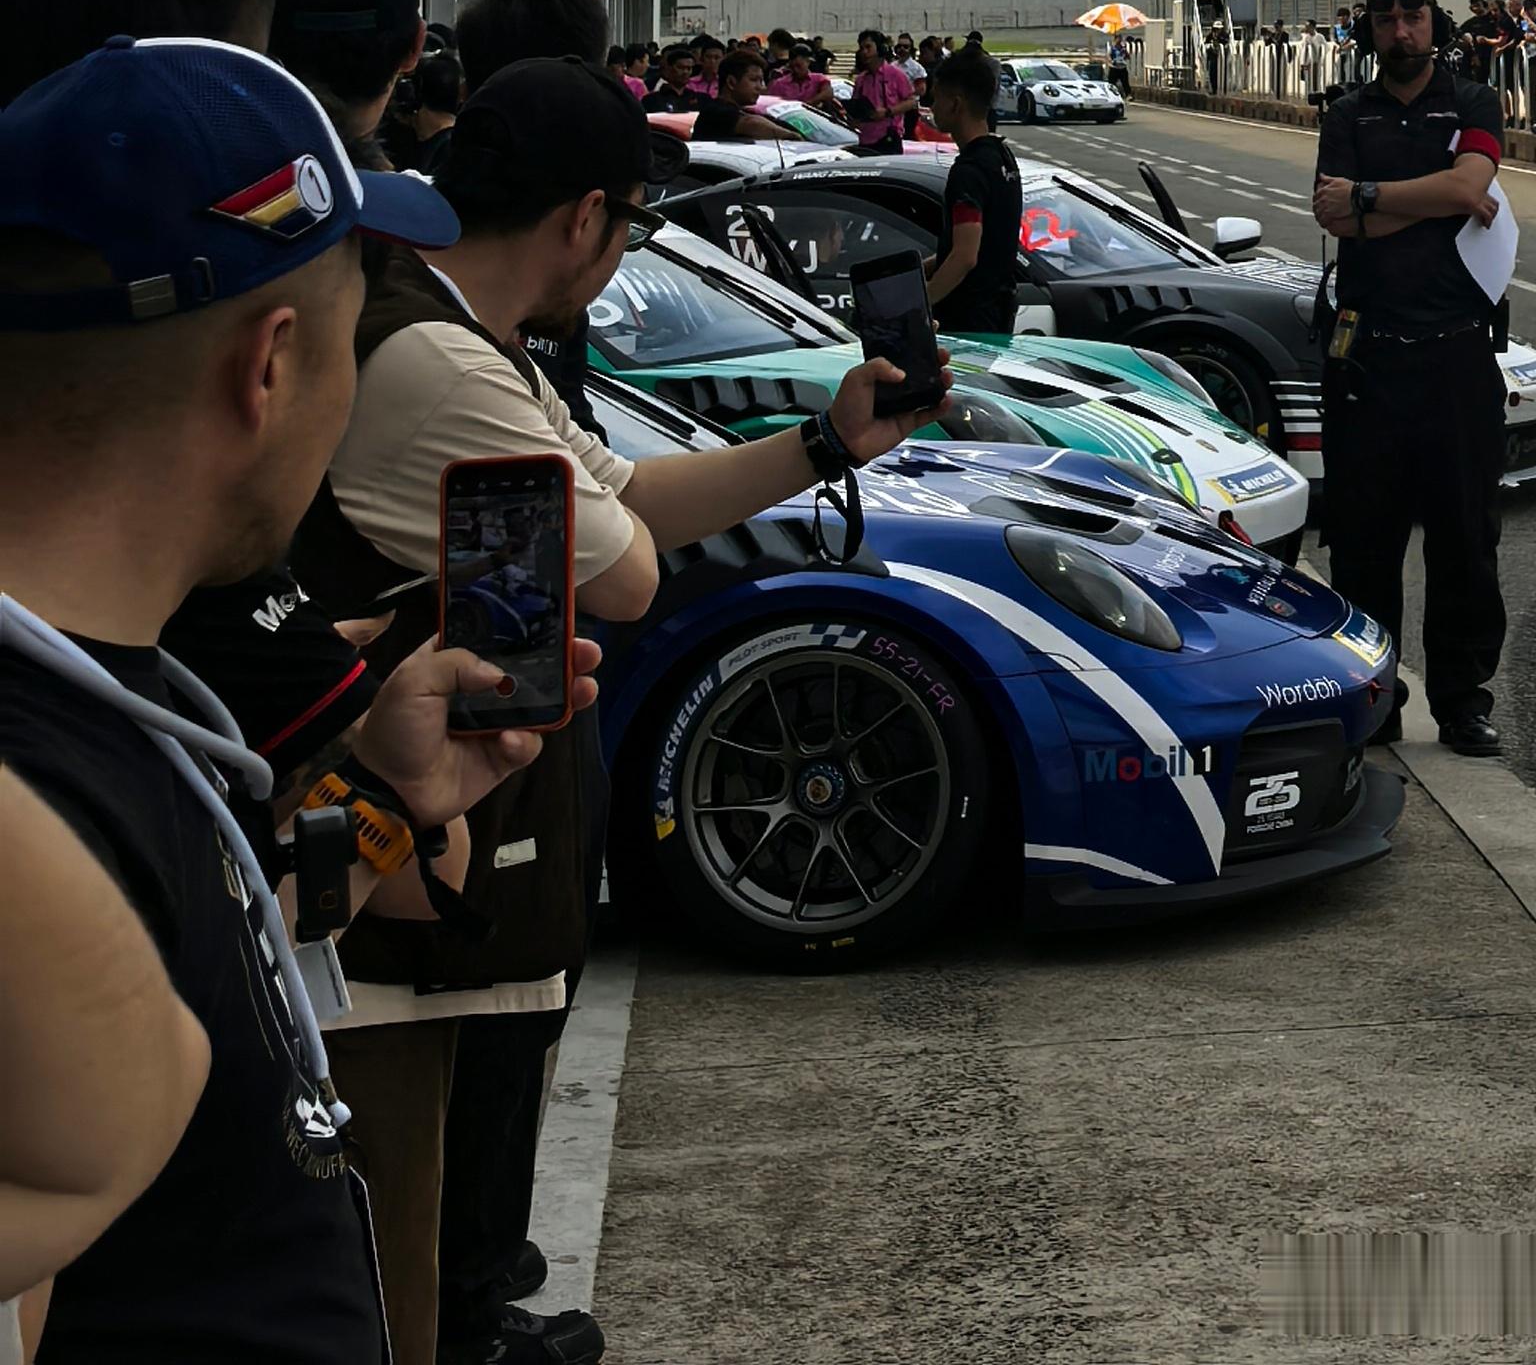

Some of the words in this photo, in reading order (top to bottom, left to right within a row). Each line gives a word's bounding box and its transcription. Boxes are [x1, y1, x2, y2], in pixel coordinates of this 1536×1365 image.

[1241, 469, 1287, 490] MICHELIN
[758, 632, 801, 650] SPORT
[657, 673, 715, 792] MICHELIN
[1084, 745, 1188, 782] Mobil
[1201, 745, 1212, 773] 1
